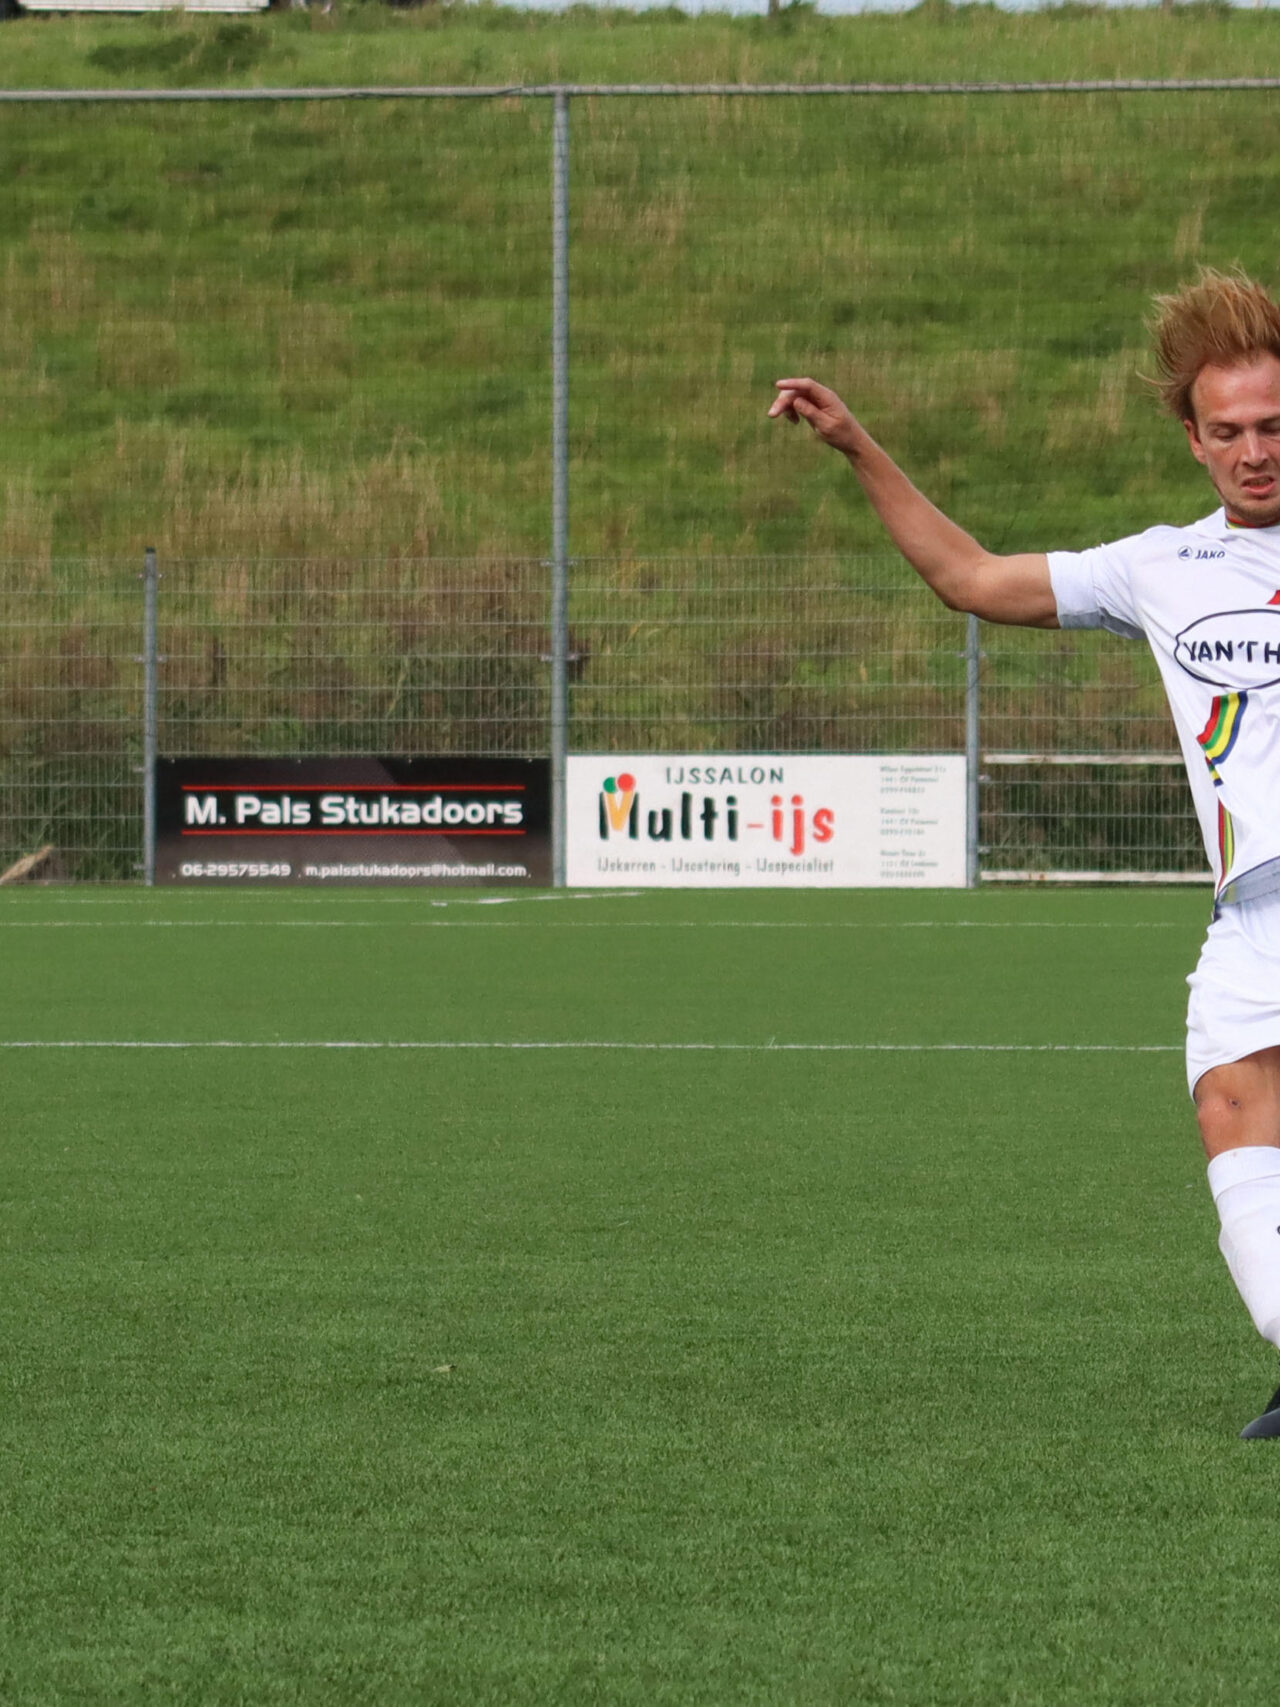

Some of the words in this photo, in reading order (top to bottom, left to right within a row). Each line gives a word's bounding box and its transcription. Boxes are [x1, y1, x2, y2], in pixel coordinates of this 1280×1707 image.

[666, 767, 784, 784] IJSSALON
[184, 797, 227, 825] M.
[235, 797, 311, 825] Pals
[320, 797, 524, 825] Stukadoors
